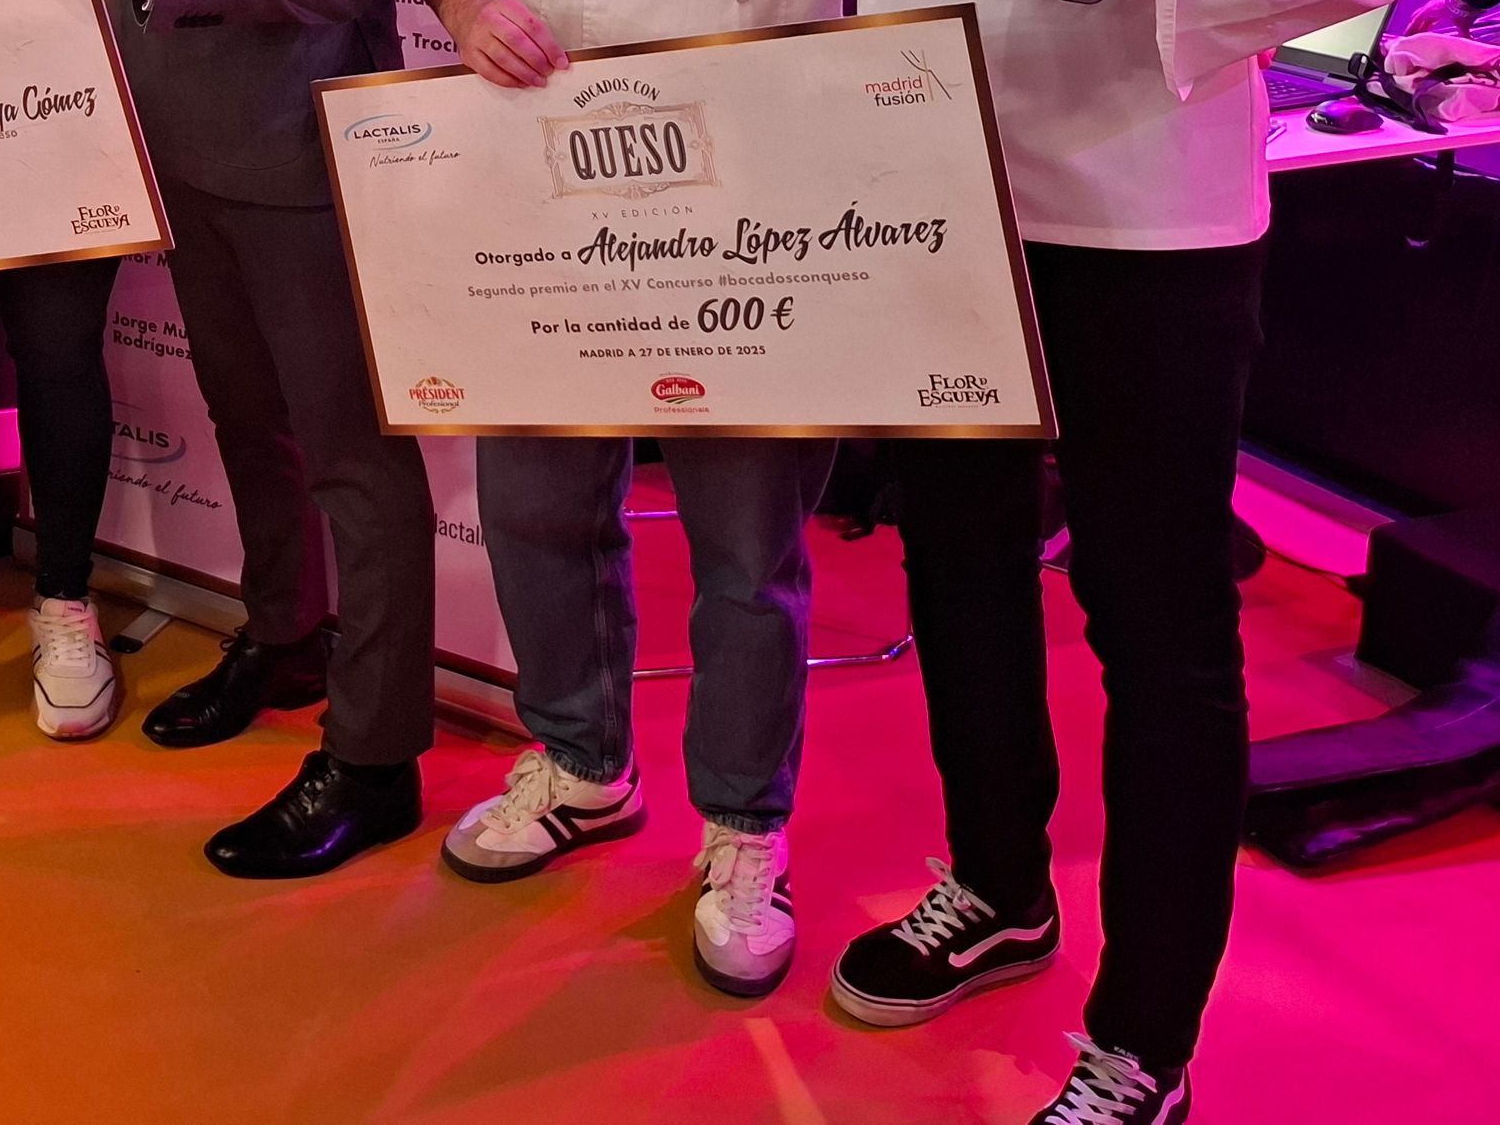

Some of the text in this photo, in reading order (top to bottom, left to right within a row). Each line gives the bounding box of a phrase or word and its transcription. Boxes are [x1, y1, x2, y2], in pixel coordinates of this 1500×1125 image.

[573, 78, 661, 109] BOCADOS CON
[865, 75, 923, 94] madrid
[22, 85, 97, 120] Gómez
[874, 90, 926, 107] fusión
[354, 124, 421, 140] LACTALIS
[370, 153, 415, 168] Nutriendo
[569, 121, 687, 181] QUESO
[78, 204, 119, 221] FLOR
[592, 211, 609, 220] XV
[71, 214, 131, 235] ESGUEVA
[475, 200, 947, 272] Otorgado a Alejandro López Álvarez
[467, 271, 870, 299] Segundo premio en el XV Concurso #bocadosconqueso
[112, 311, 158, 335] Jorge
[531, 321, 560, 335] Por
[564, 318, 581, 333] la
[587, 315, 662, 332] cantidad
[668, 313, 691, 330] de
[697, 296, 765, 333] 600
[113, 329, 193, 360] Rodríguez
[579, 345, 766, 359] MADRID A 27 DE ENERO DE 2025
[655, 383, 700, 396] Galbani
[928, 374, 986, 391] FLOR
[409, 387, 465, 402] PRÉSIDENT
[917, 389, 1001, 407] ESGUEVA
[154, 479, 172, 494] el
[171, 484, 222, 509] futuro
